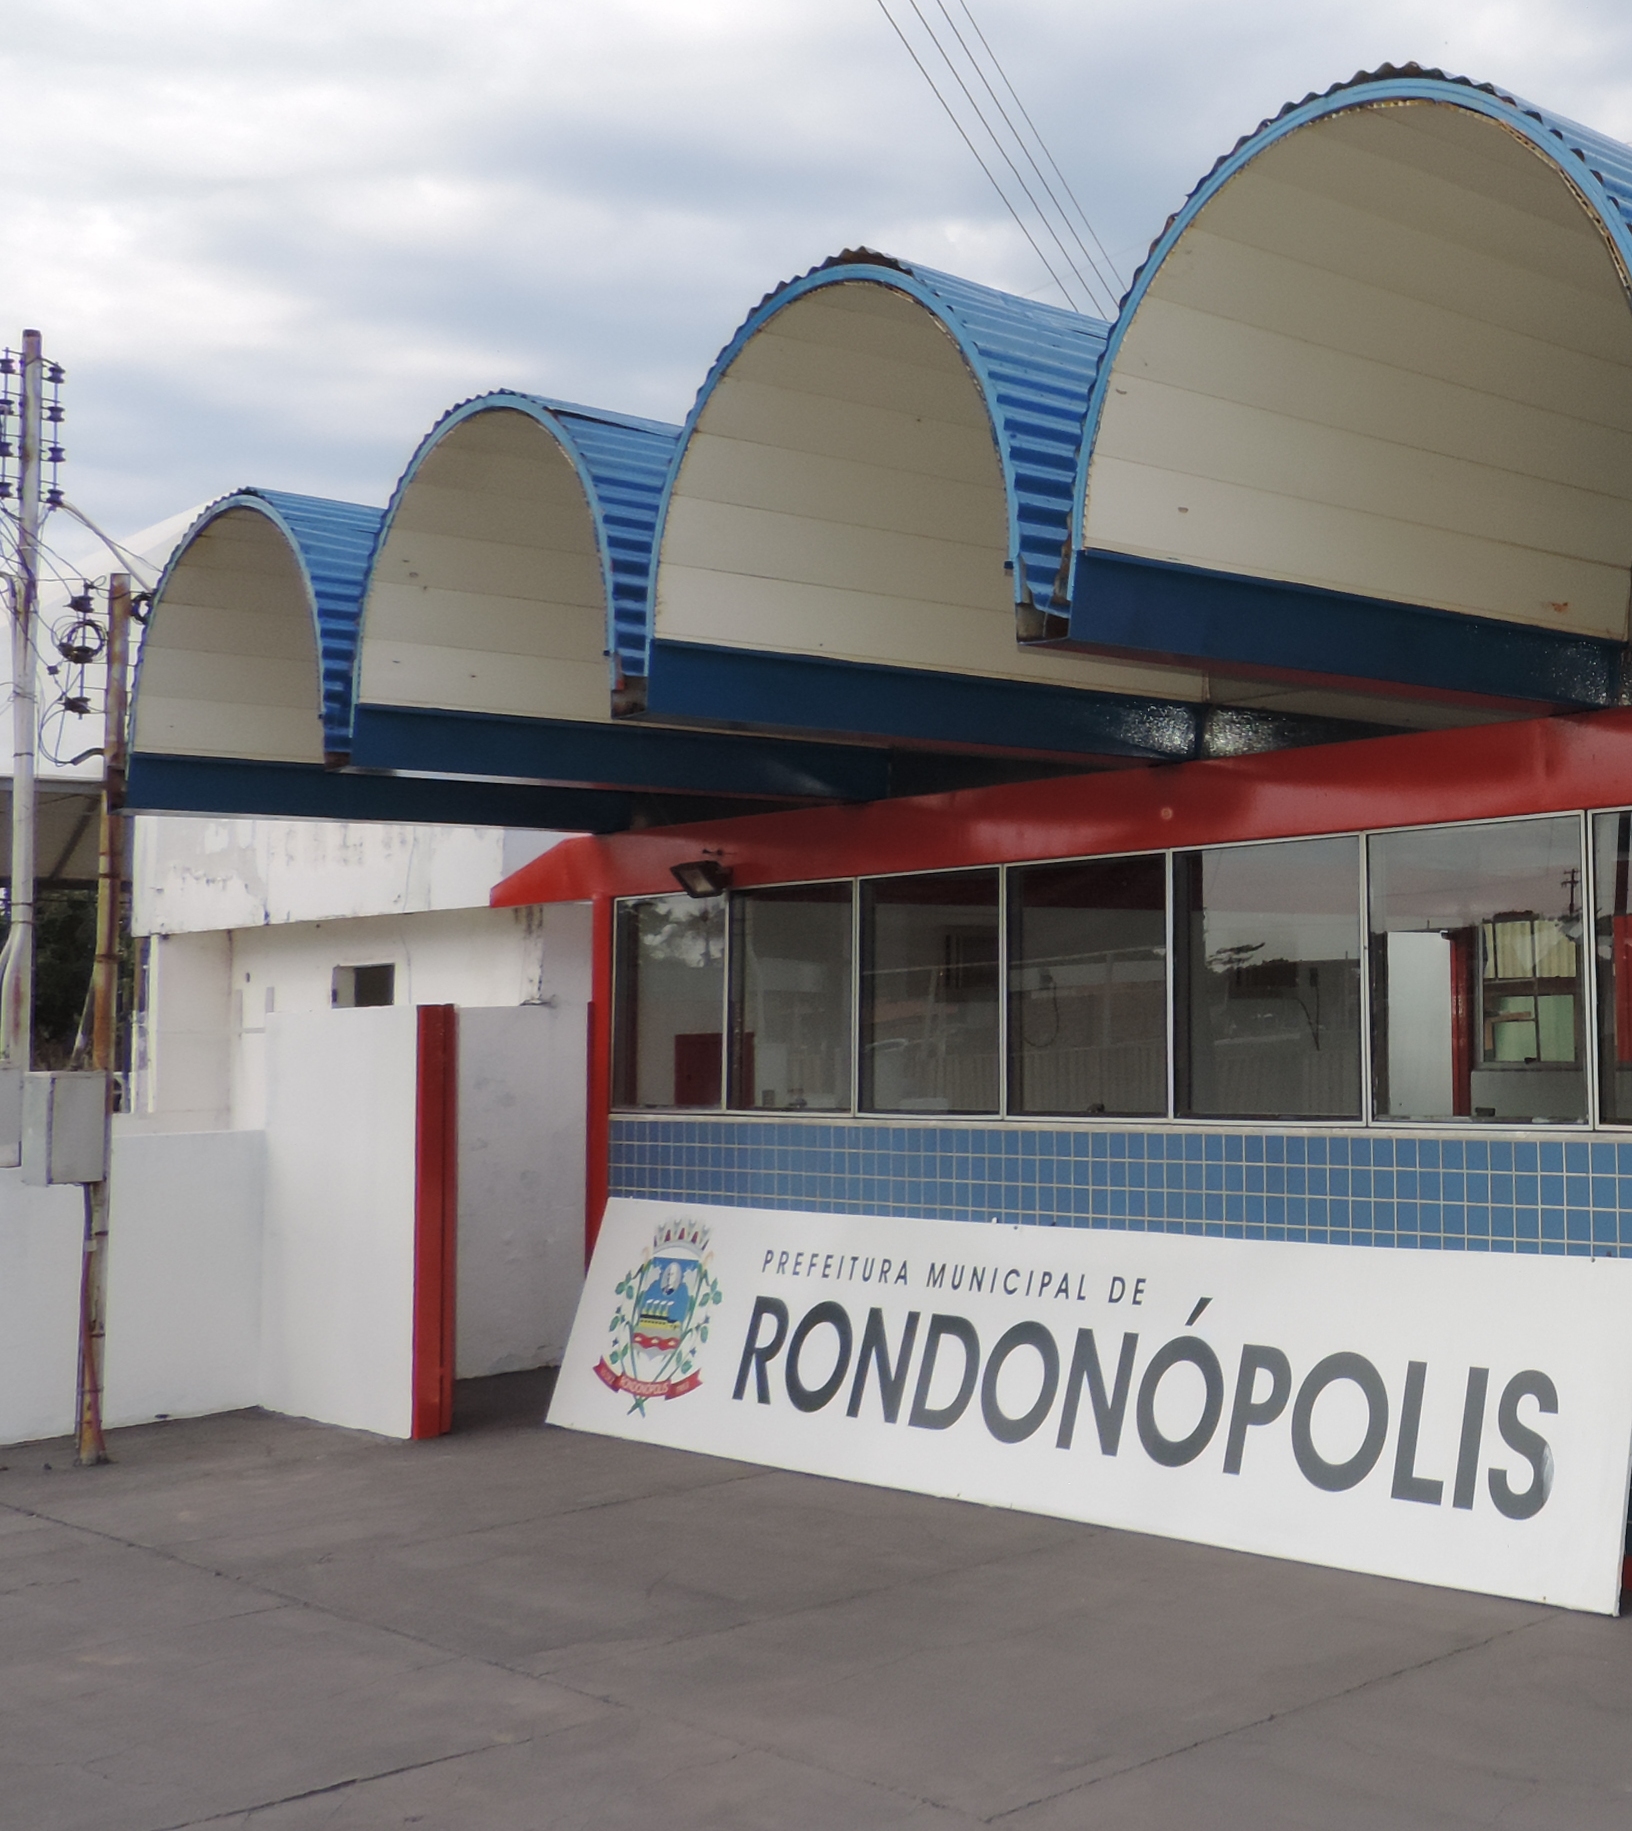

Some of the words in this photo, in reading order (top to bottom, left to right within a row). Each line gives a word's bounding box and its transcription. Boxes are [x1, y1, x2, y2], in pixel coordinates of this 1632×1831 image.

[761, 1249, 909, 1286] PREFEITURA
[926, 1262, 1089, 1301] MUNICIPAL
[1108, 1276, 1147, 1306] DE
[732, 1296, 1559, 1521] RONDONÓPOLIS
